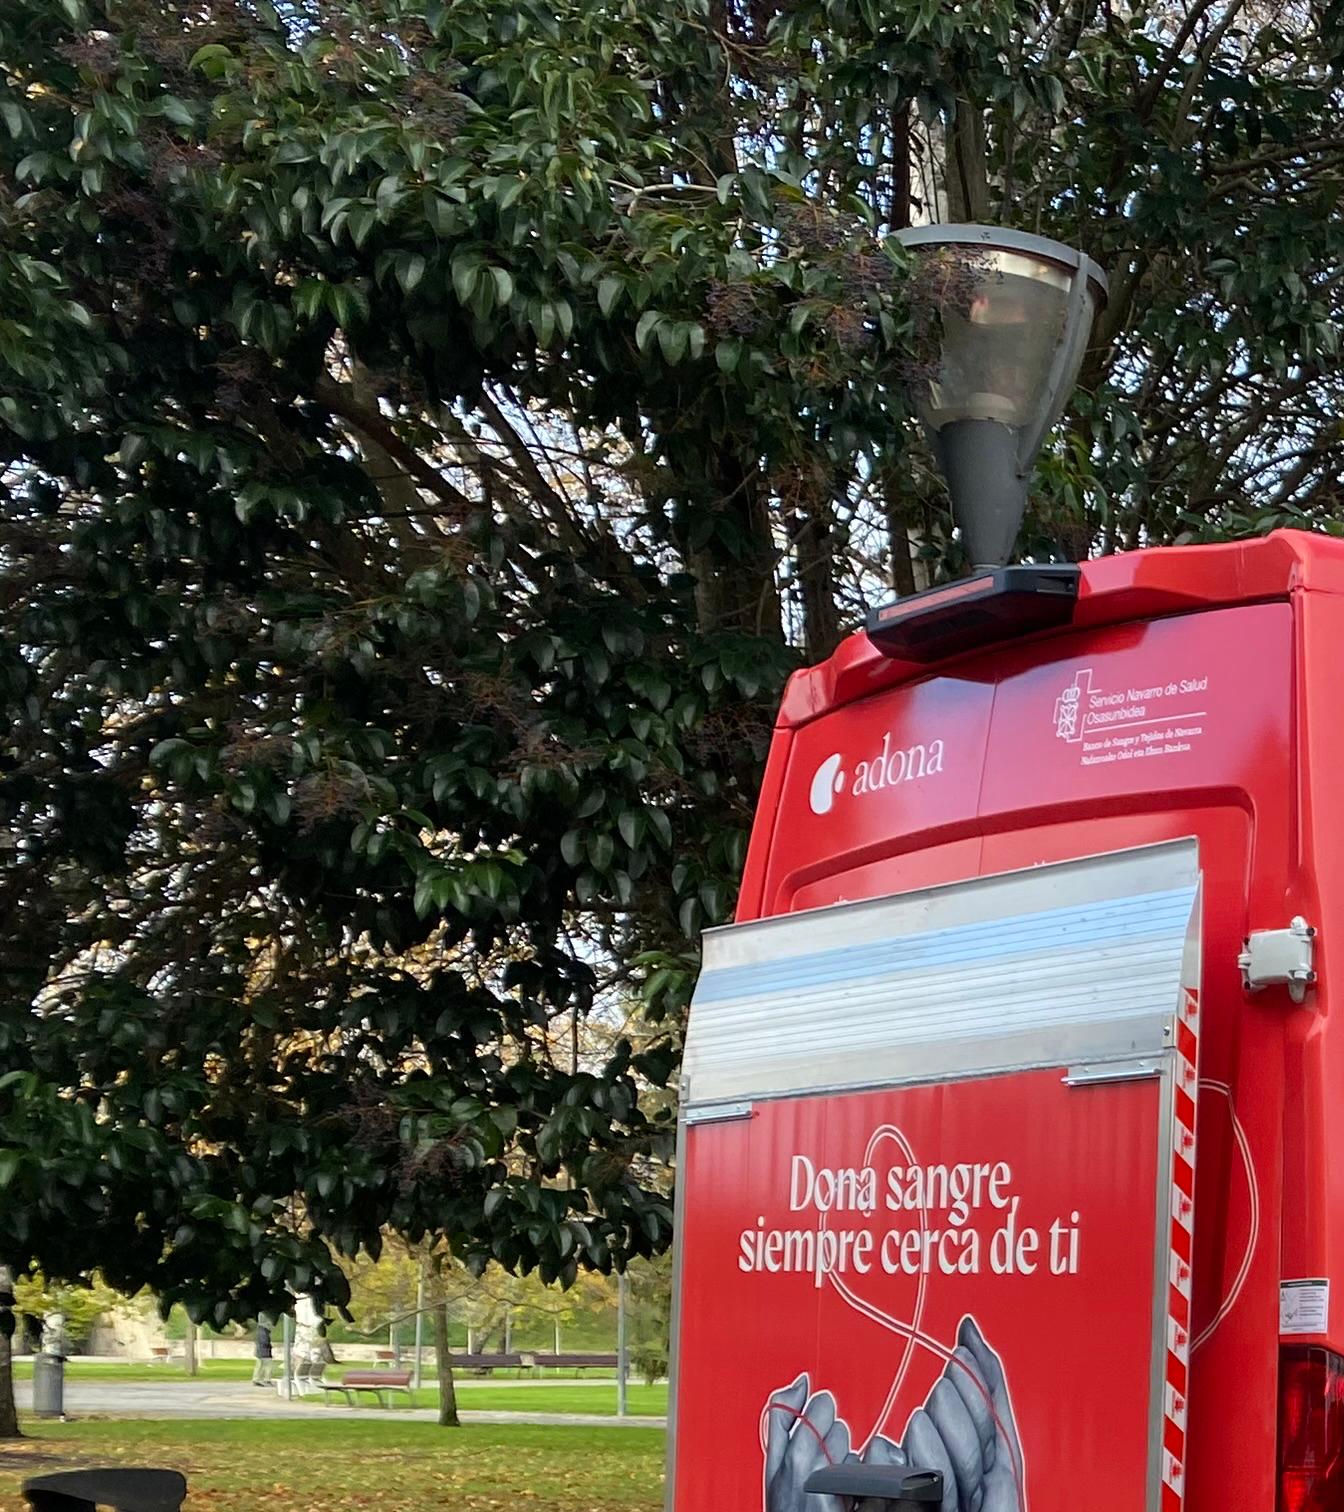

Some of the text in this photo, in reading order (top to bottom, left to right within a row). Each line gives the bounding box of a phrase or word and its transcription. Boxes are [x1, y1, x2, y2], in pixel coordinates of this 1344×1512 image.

[1086, 705, 1146, 725] Osasunbidea
[1088, 676, 1208, 709] Servicio Navarro de Salud
[851, 731, 944, 796] adona
[790, 1155, 1019, 1226] Dona sangre,
[738, 1211, 1080, 1288] siempre cerca de ti
